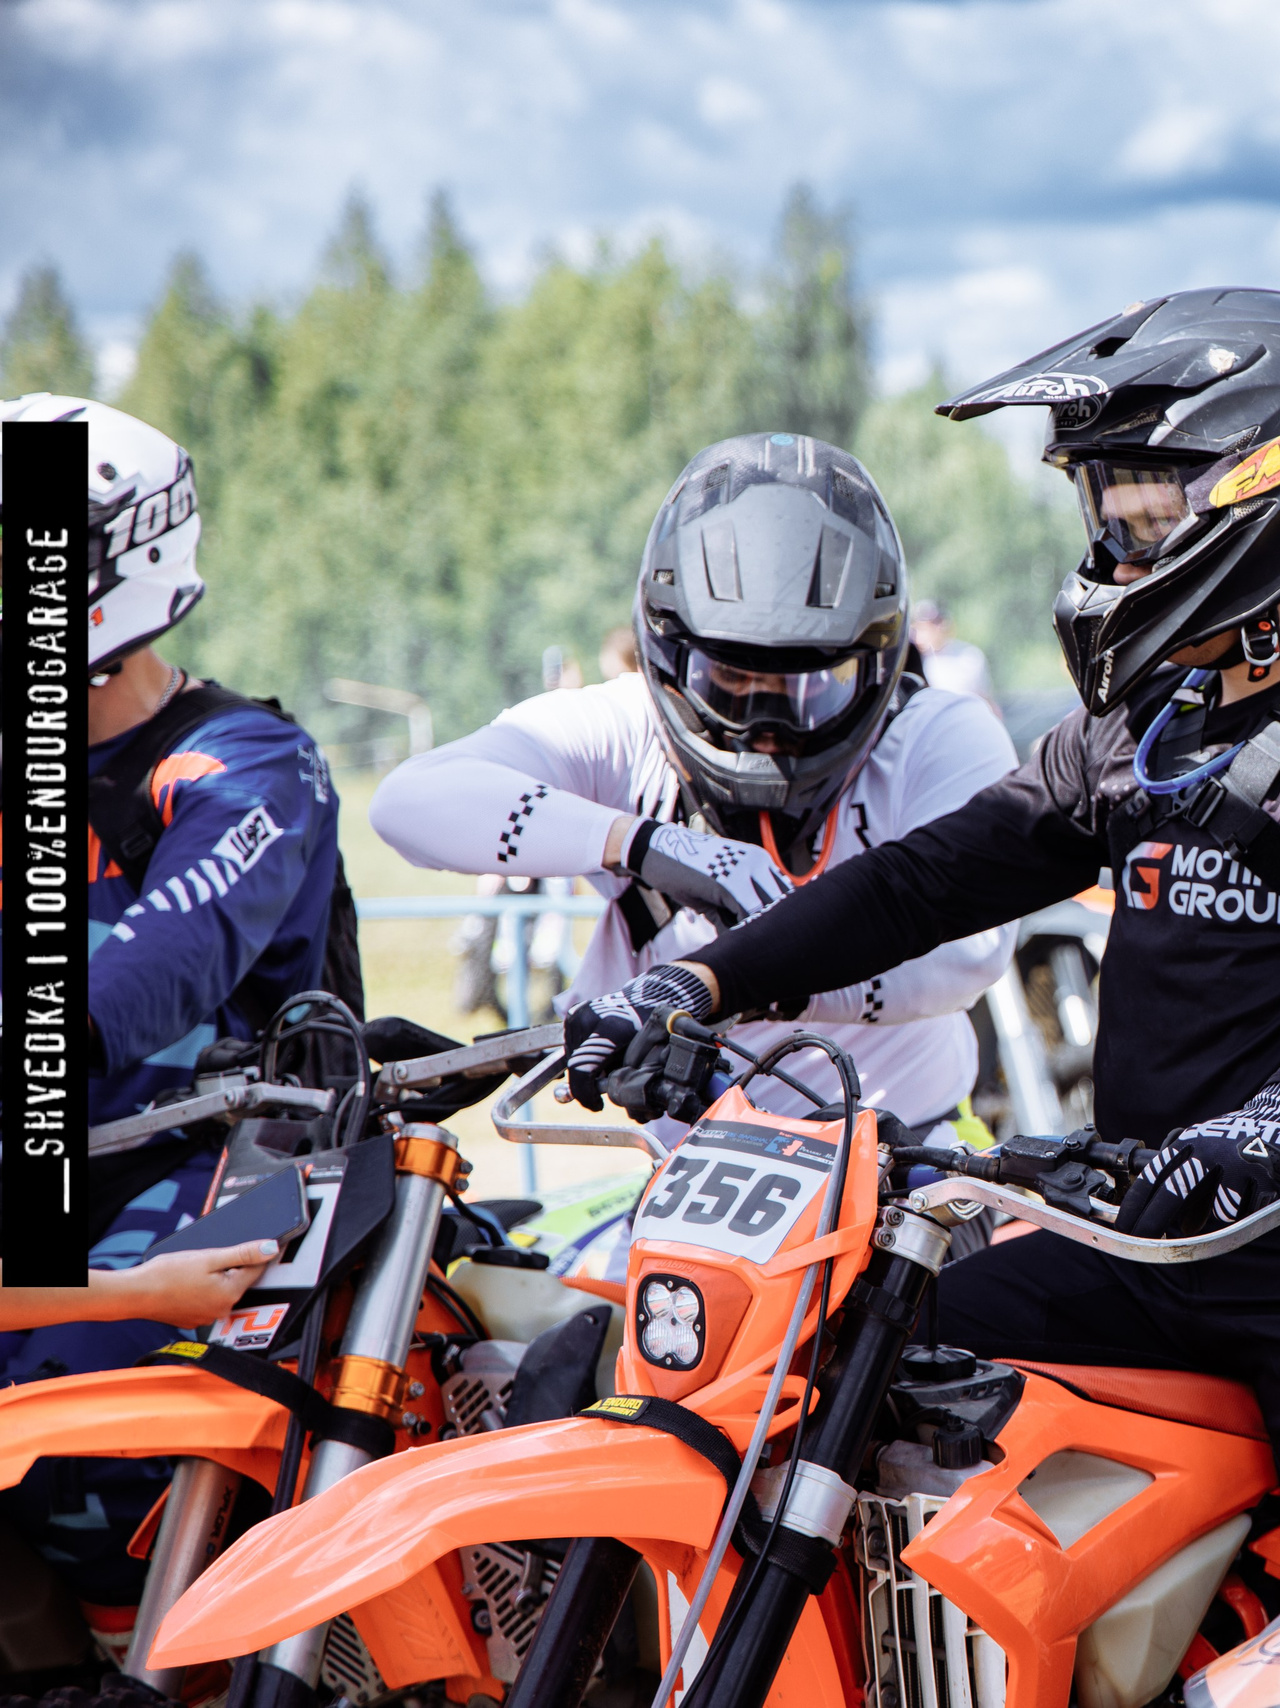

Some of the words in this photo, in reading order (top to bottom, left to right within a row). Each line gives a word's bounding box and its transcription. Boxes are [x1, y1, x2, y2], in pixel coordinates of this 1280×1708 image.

[982, 377, 1091, 401] Airoh
[1097, 649, 1114, 704] Airoh
[642, 1155, 802, 1237] 356
[602, 1397, 644, 1410] ENDURO
